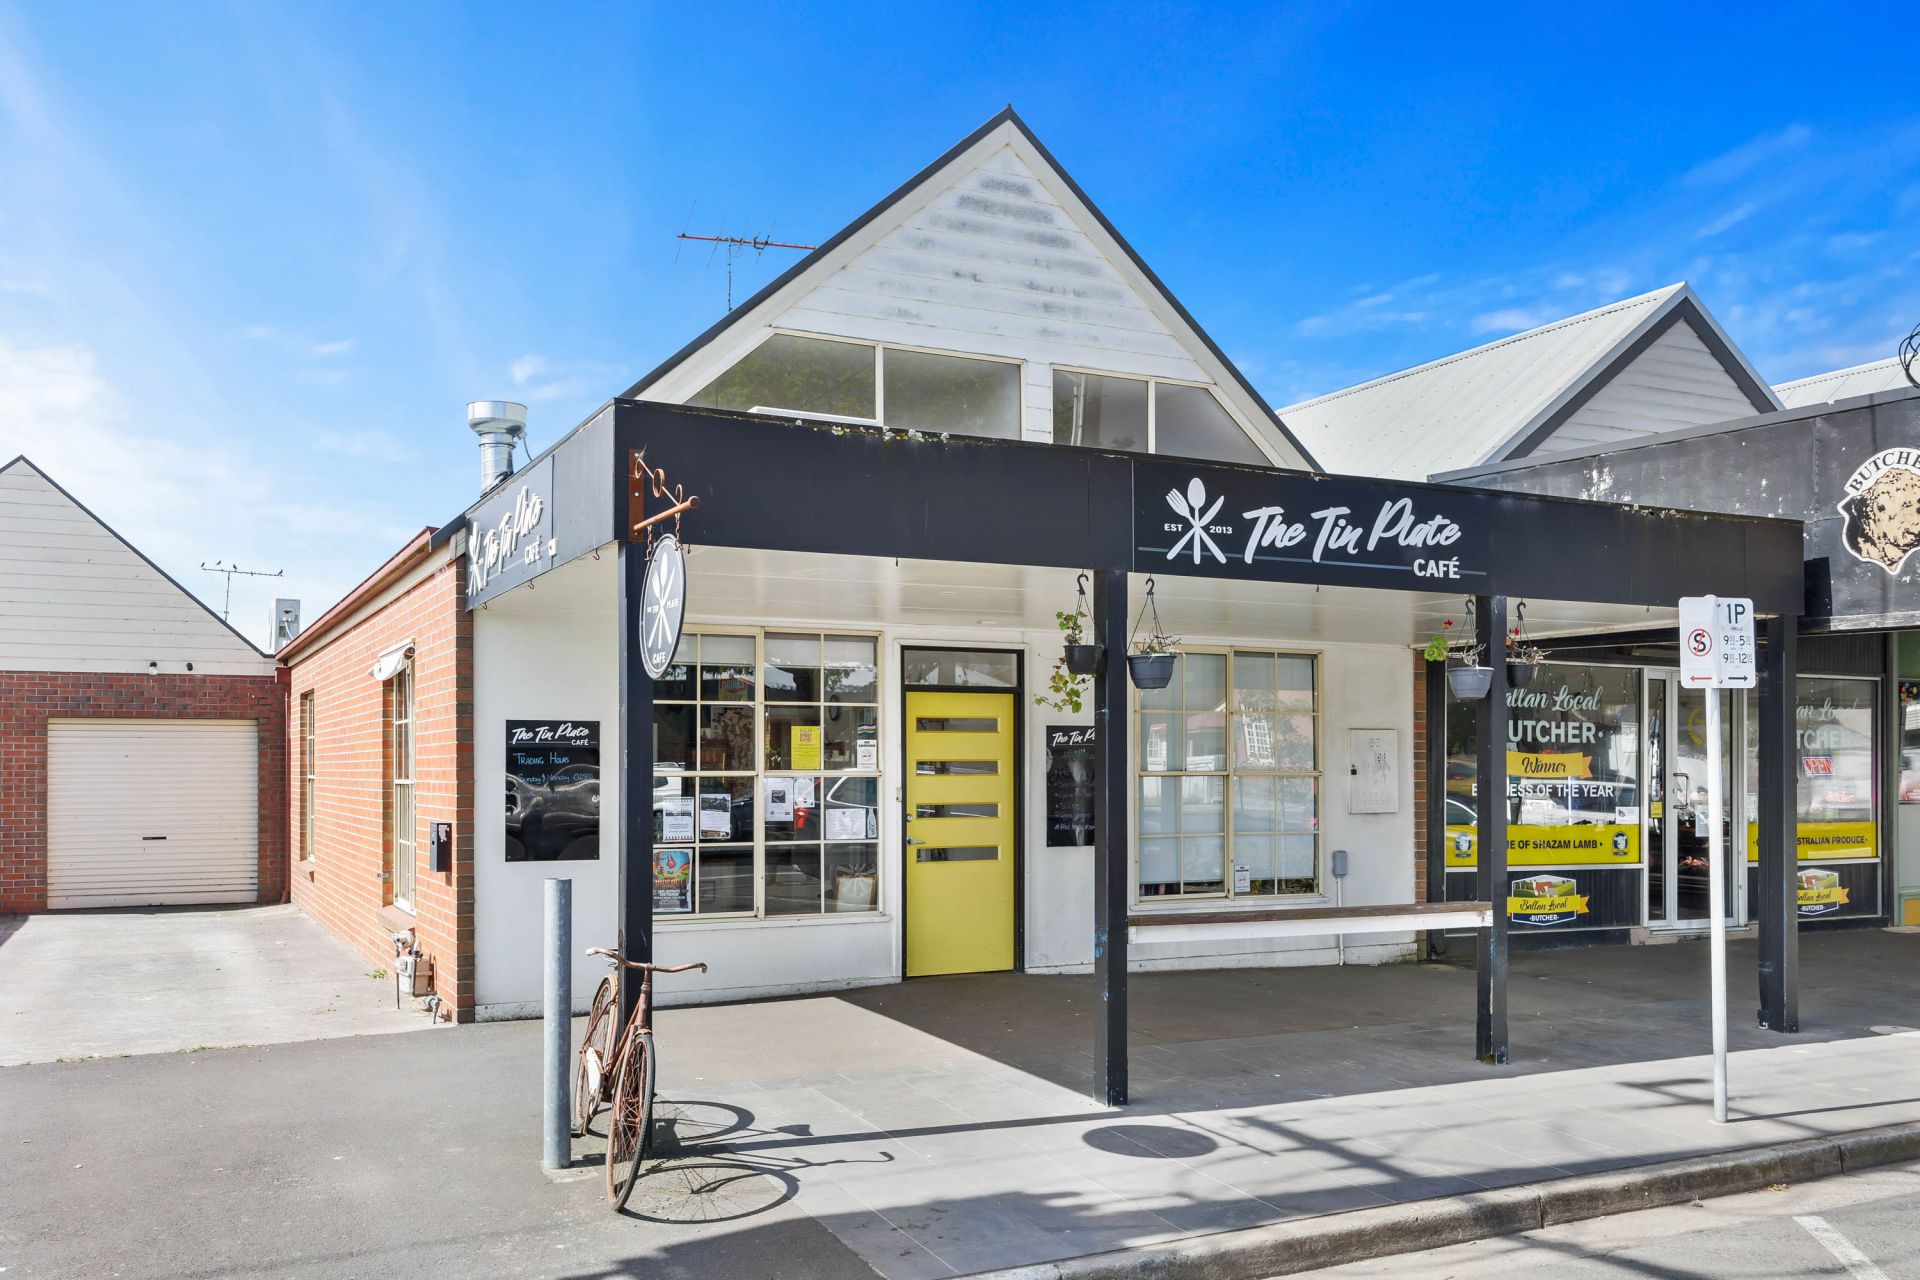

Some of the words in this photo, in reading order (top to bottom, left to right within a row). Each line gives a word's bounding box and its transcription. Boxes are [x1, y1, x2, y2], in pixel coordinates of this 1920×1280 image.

[1849, 450, 1920, 492] BUTCHE
[1164, 523, 1183, 533] EST
[1208, 524, 1234, 535] 2013
[1242, 506, 1307, 565] The
[1310, 506, 1364, 564] Tin
[1366, 497, 1462, 552] Plate
[1412, 555, 1461, 580] CAFÉ
[1726, 603, 1746, 624] 1P
[1506, 688, 1550, 709] allan
[1551, 684, 1604, 712] Local
[512, 727, 534, 745] The
[535, 727, 553, 744] Tin
[555, 722, 590, 740] Plate
[1052, 732, 1069, 748] The
[1069, 731, 1083, 746] Tin
[1507, 720, 1597, 744] UTCHER
[571, 738, 589, 746] CAFÉ
[1521, 756, 1568, 774] Winner
[1536, 784, 1553, 798] OF
[1555, 784, 1580, 798] THE
[1583, 784, 1615, 798] YEAR
[1517, 839, 1530, 850] OF
[1532, 839, 1571, 850] SHAZAM
[1573, 839, 1598, 850] LAMB
[1831, 835, 1865, 844] PRODUCE
[1519, 898, 1547, 911] Ballan
[1547, 898, 1568, 911] Local
[1531, 913, 1559, 922] BUTCHER
